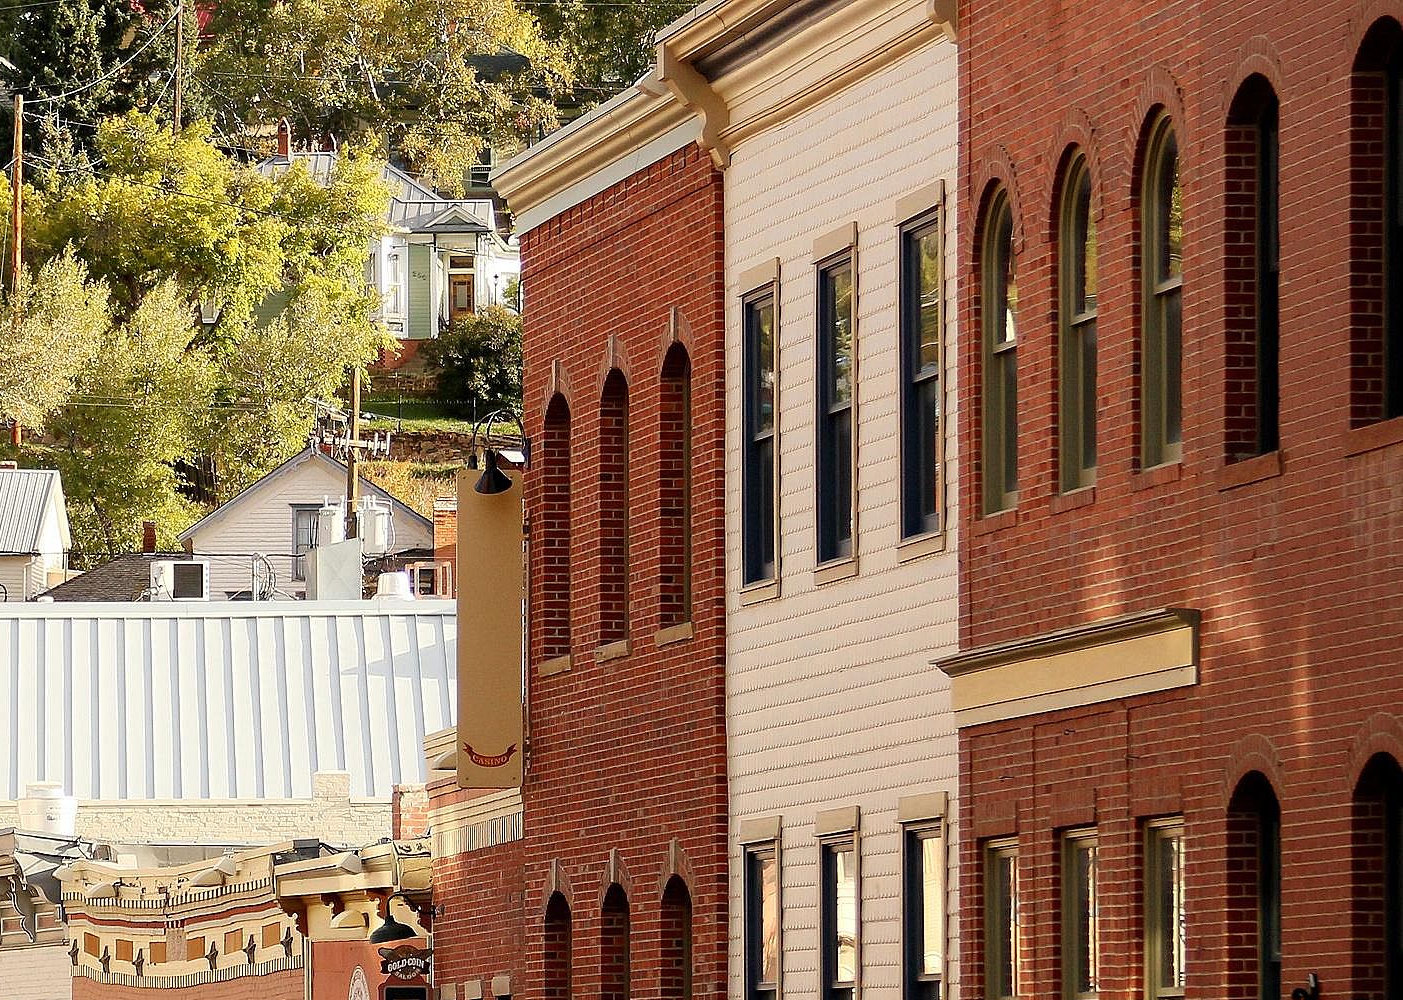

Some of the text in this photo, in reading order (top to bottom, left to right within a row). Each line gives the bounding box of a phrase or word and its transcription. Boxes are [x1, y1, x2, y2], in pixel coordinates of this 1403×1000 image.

[472, 754, 508, 766] CASINO
[387, 957, 425, 972] GOLD COIN
